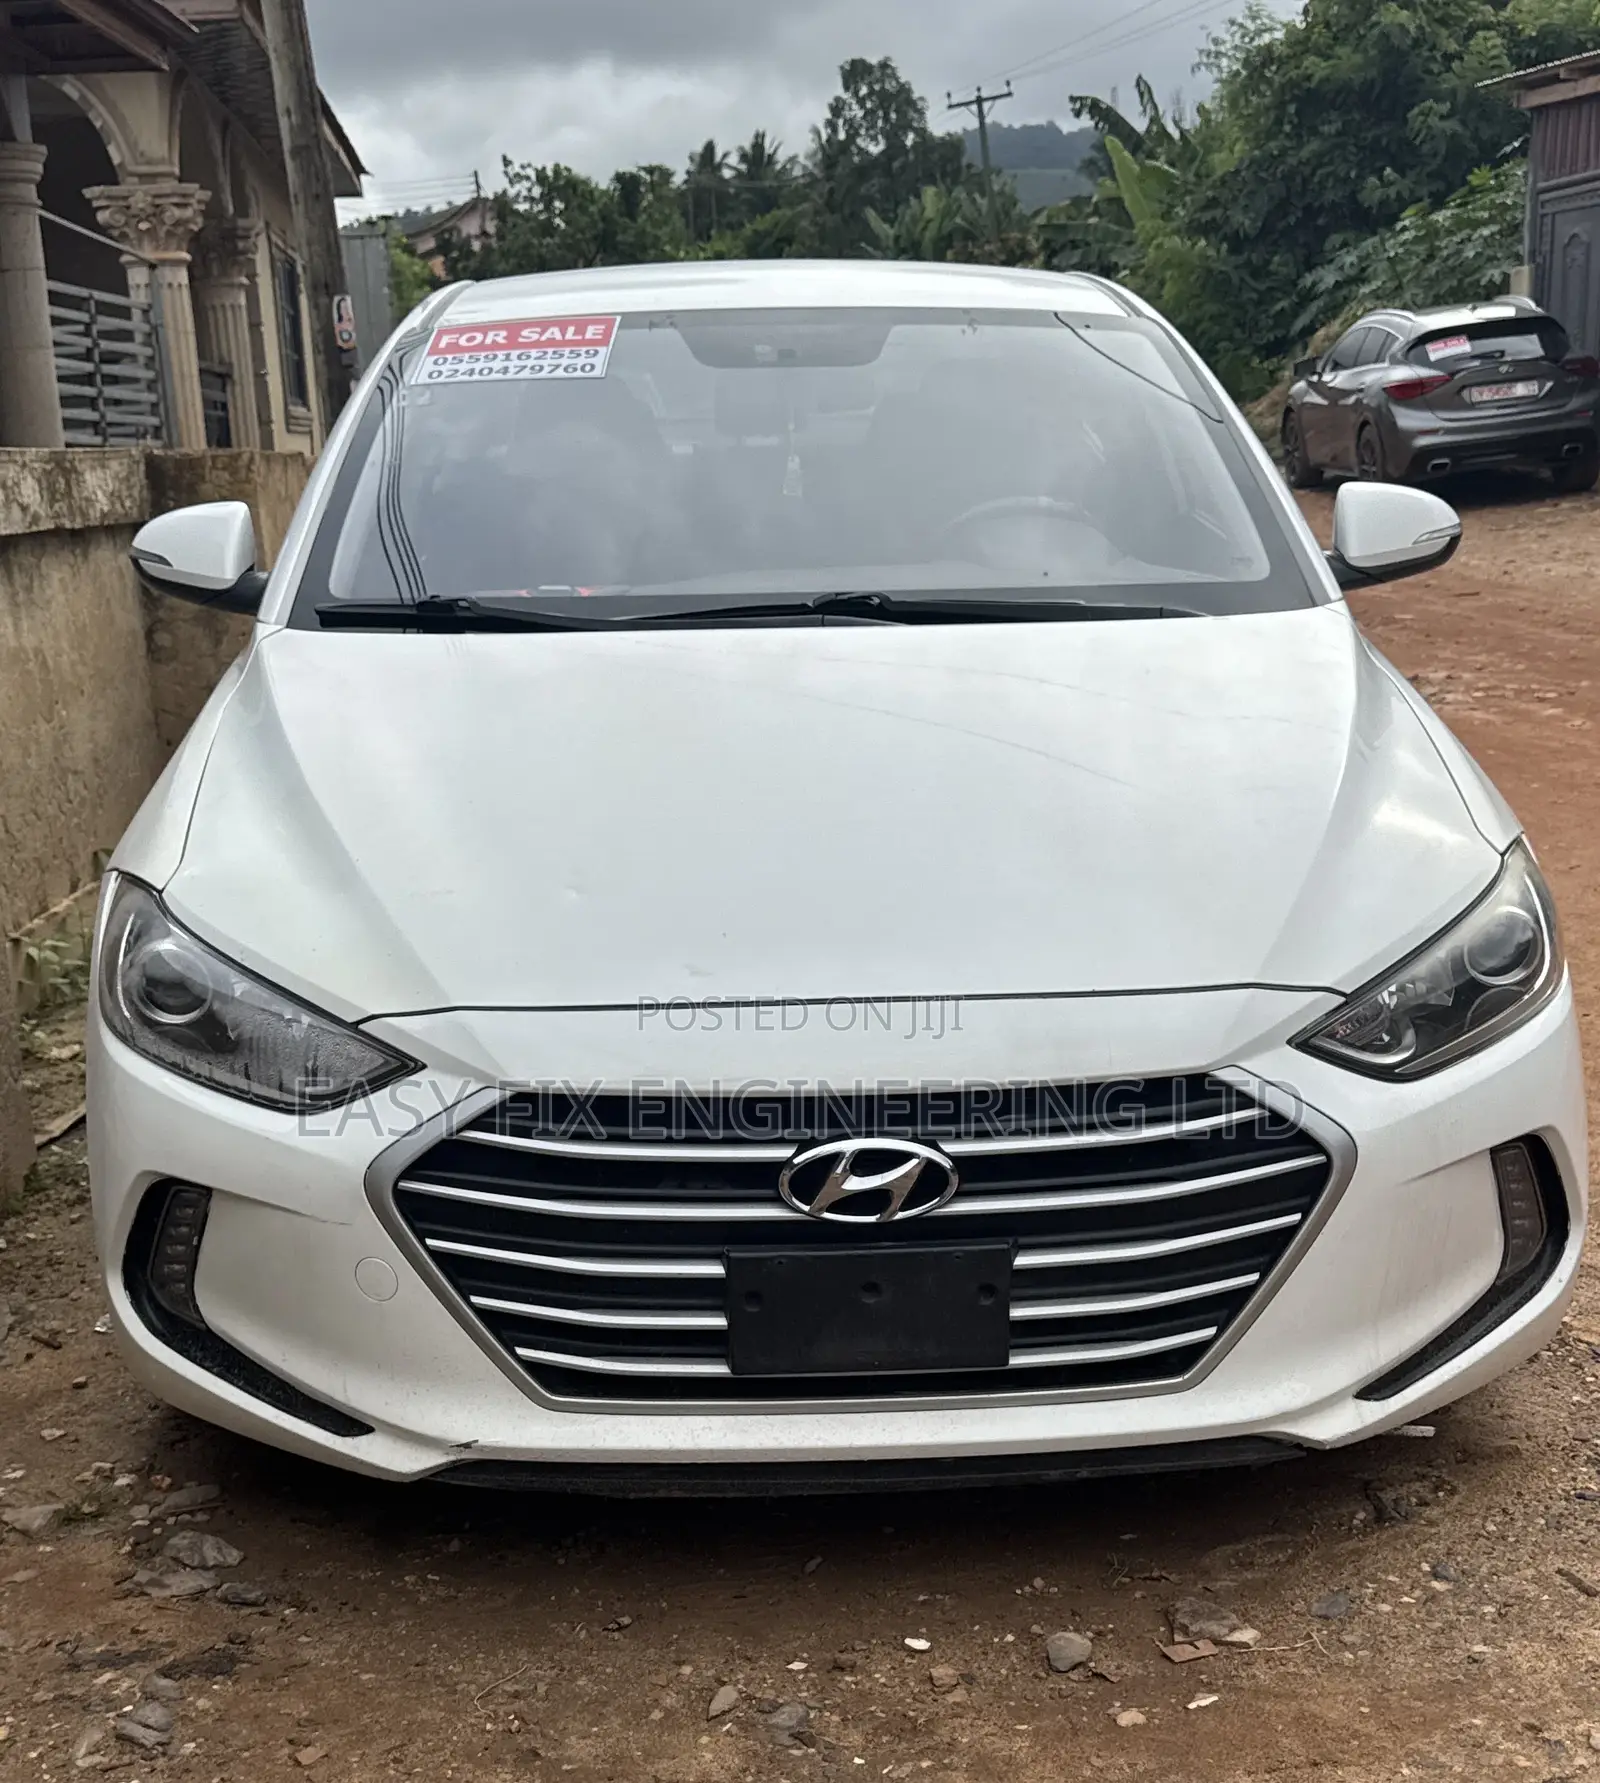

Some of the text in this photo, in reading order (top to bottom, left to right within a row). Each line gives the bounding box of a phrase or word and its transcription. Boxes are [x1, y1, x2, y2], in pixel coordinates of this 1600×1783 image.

[438, 325, 606, 348] FOR SALE
[432, 349, 599, 366] 0559162559
[427, 363, 596, 380] 0240479760
